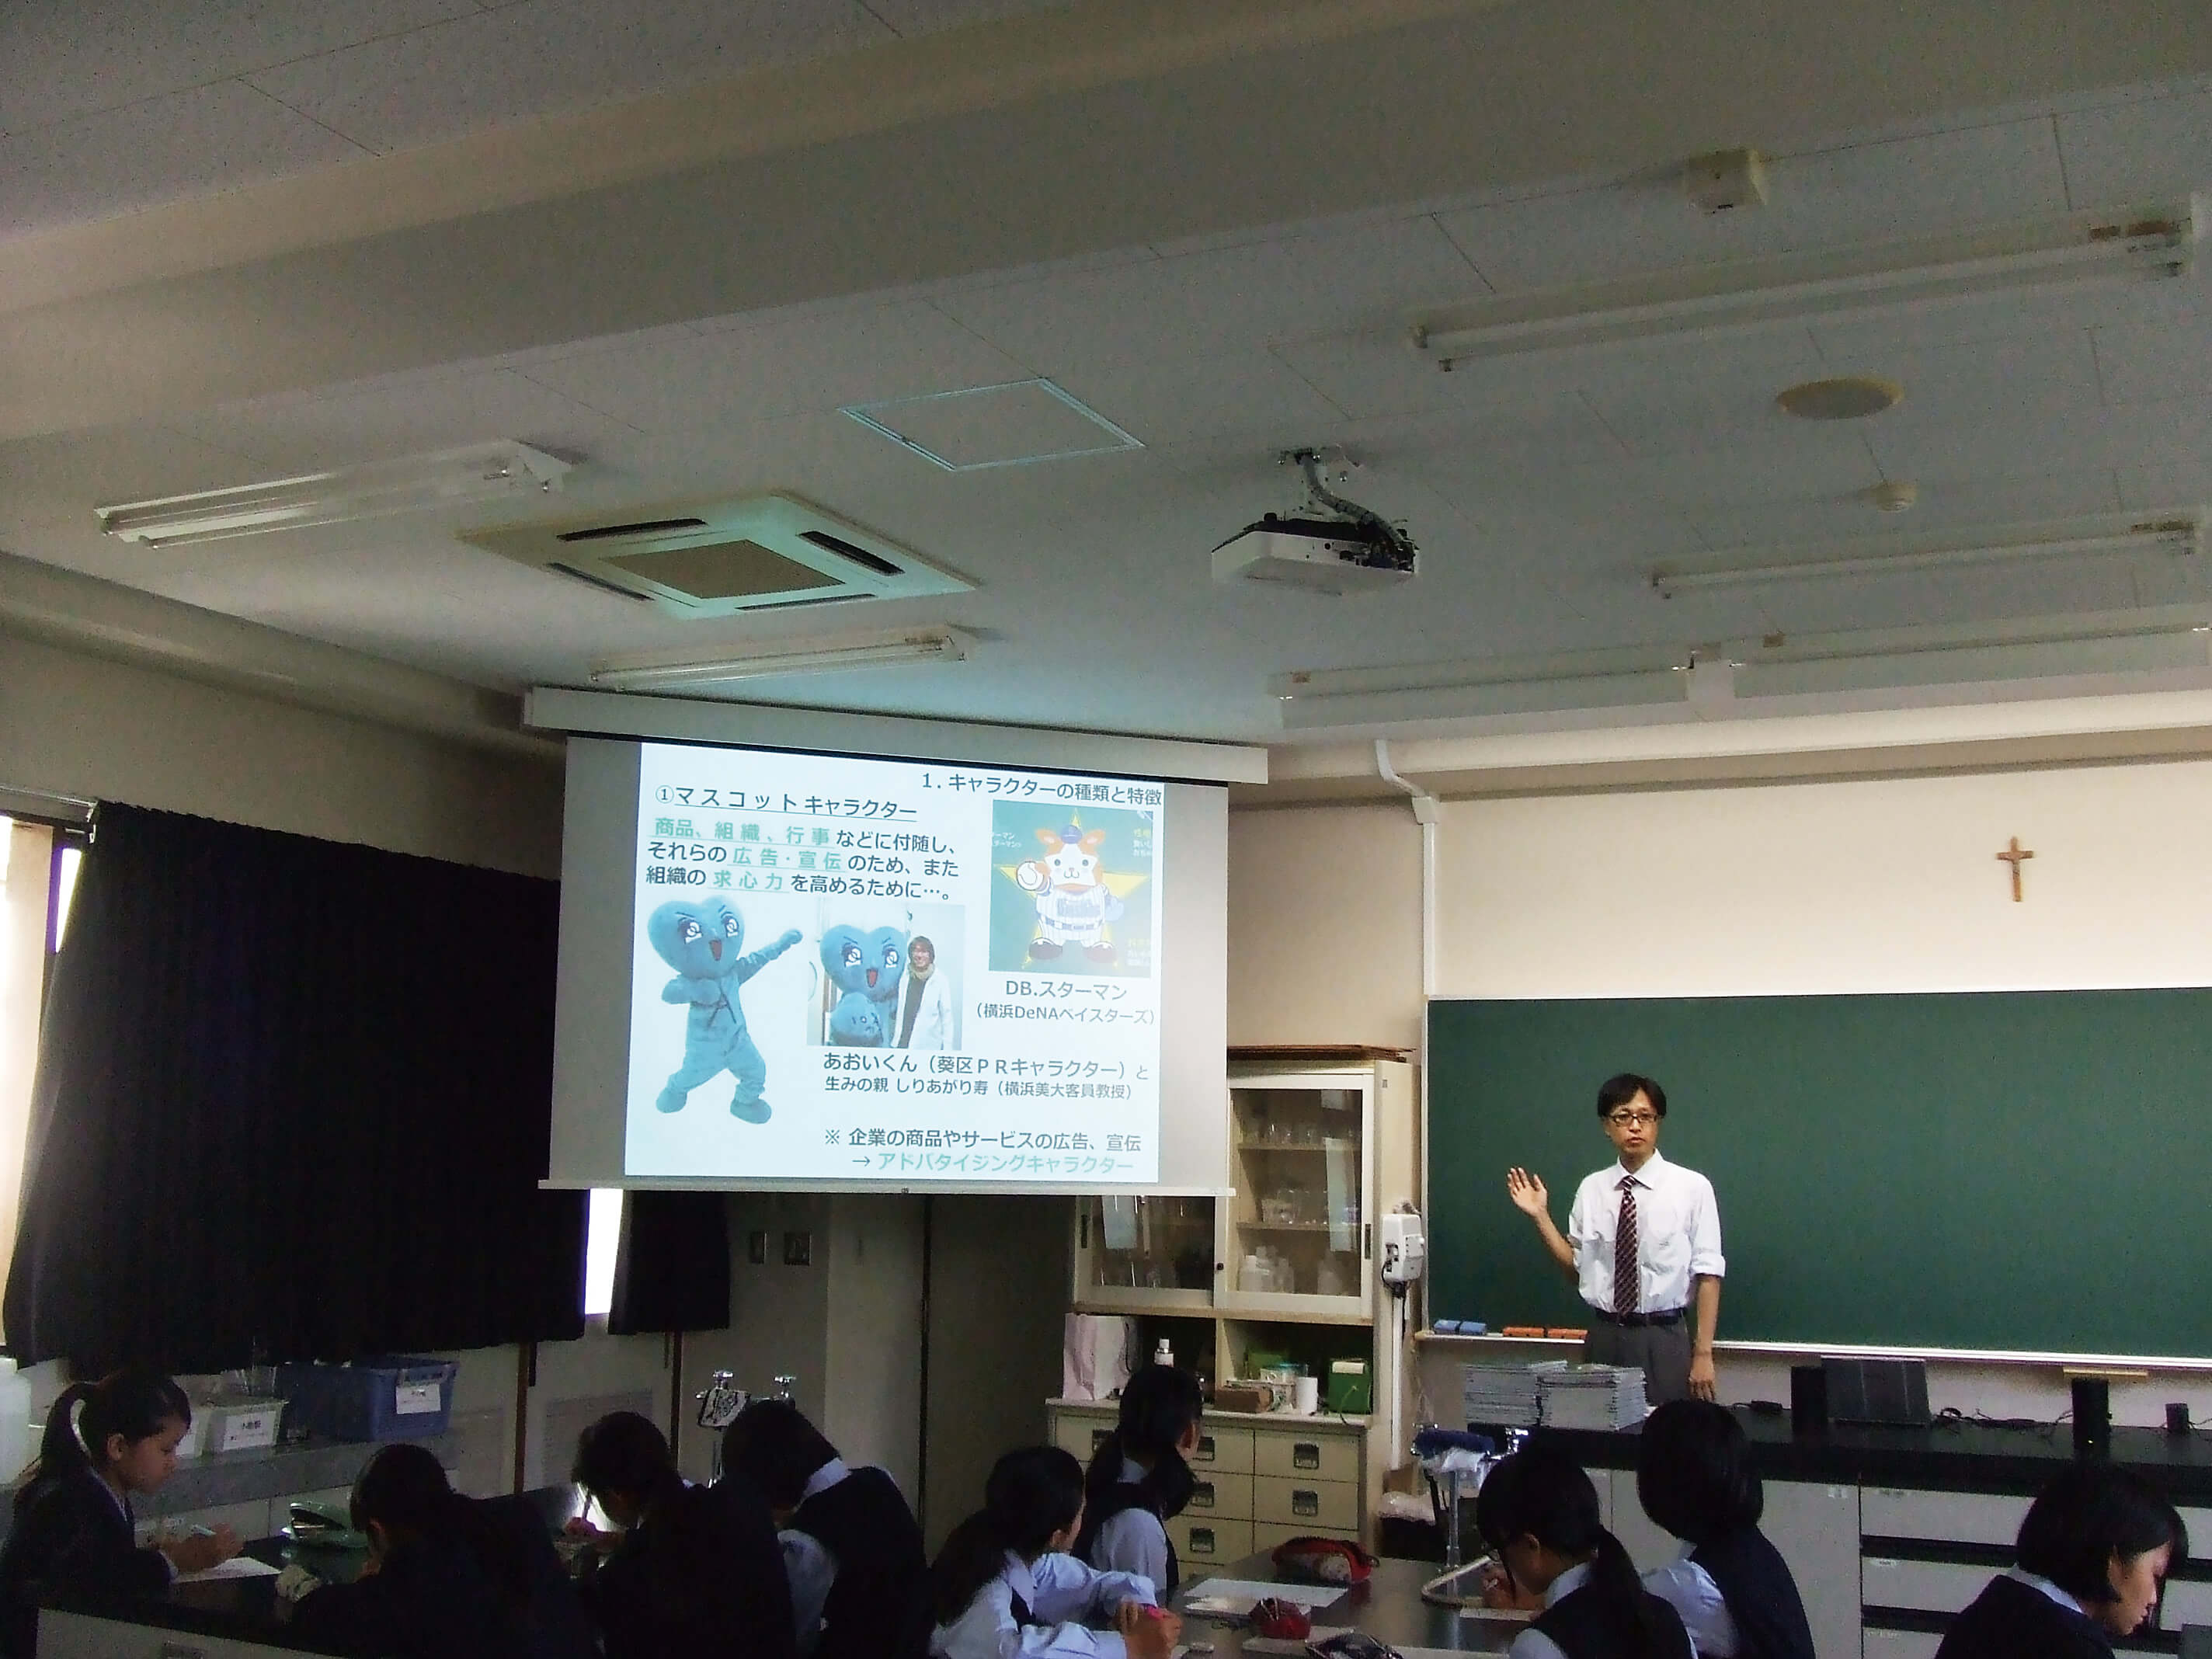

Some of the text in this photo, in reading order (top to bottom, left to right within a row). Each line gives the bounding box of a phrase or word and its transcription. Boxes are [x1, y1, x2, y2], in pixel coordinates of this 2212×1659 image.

[1005, 980, 1127, 1000] DB.スターマン
